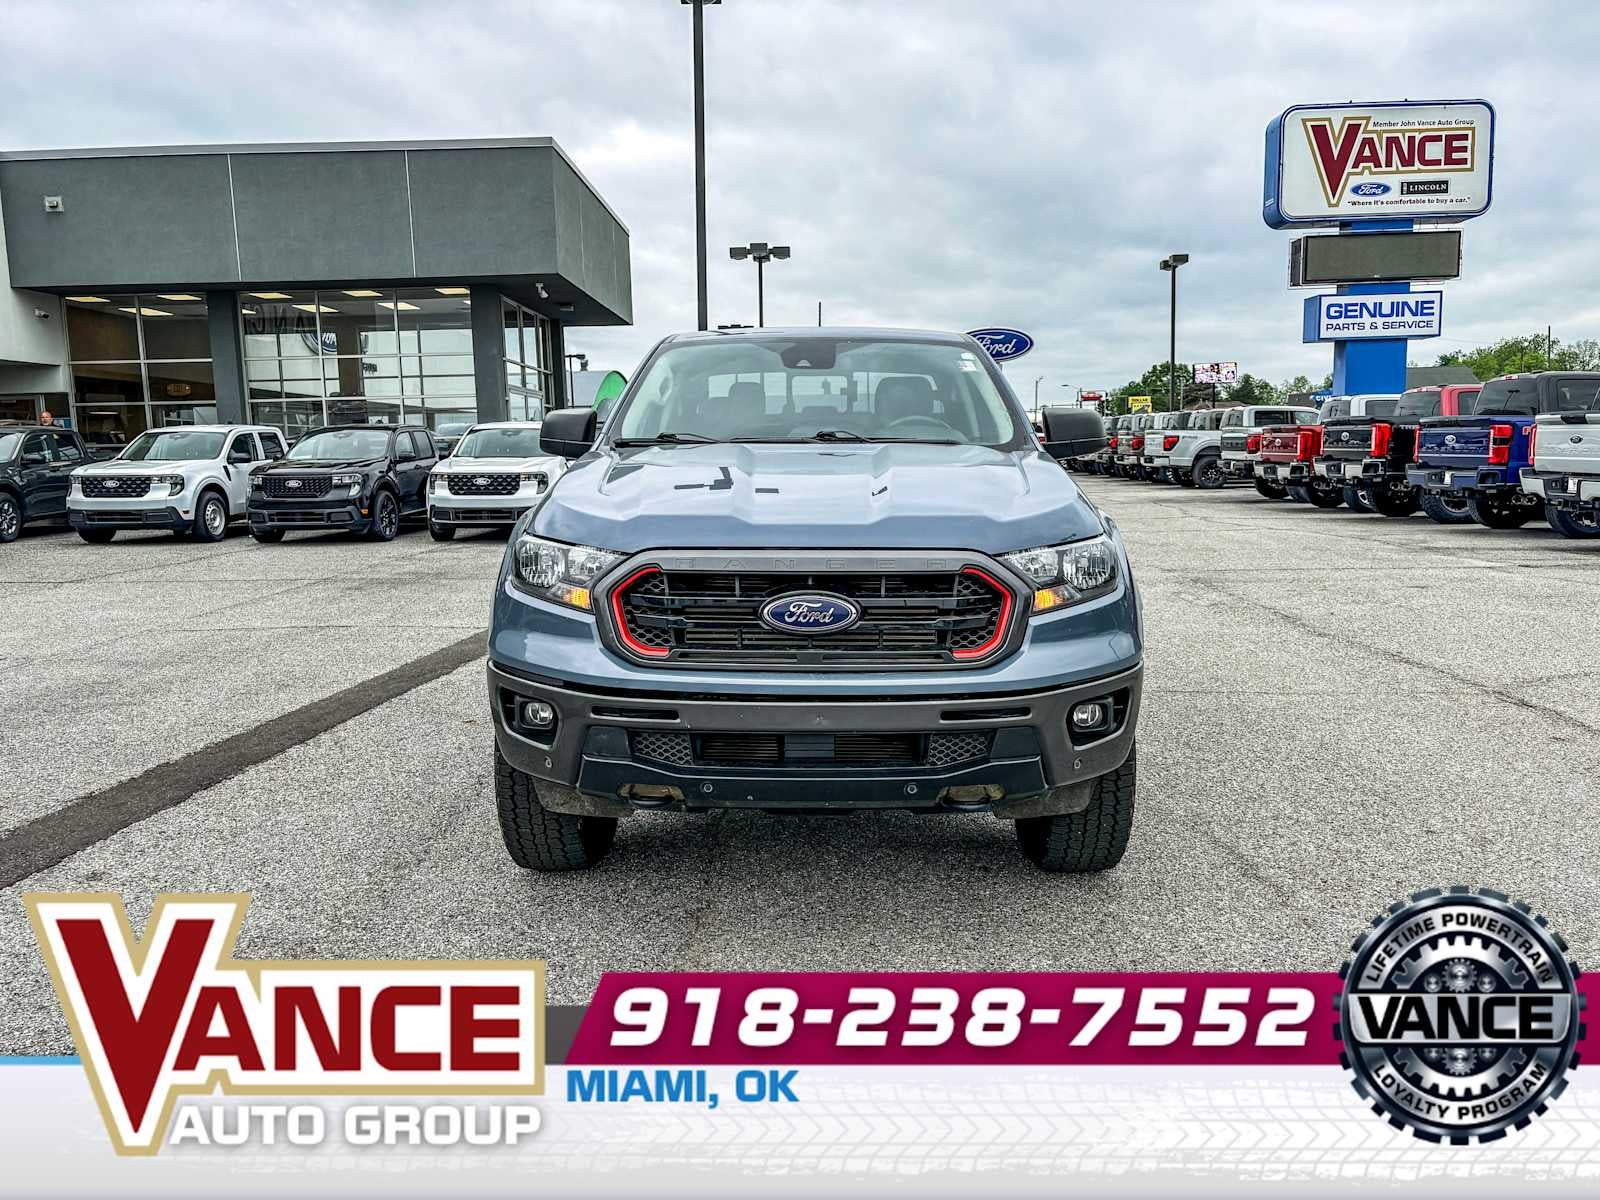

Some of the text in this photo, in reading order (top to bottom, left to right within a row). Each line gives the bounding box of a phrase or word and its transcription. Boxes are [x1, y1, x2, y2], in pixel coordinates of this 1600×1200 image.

[1454, 118, 1475, 126] Group
[1311, 123, 1469, 199] VANCE
[1358, 183, 1384, 195] Ford
[1409, 183, 1447, 191] LINCOLN
[1436, 197, 1448, 205] buy
[1326, 300, 1435, 320] GENUINE
[1326, 320, 1434, 331] PARTS & SERVICE
[976, 334, 1017, 354] Ford
[675, 558, 947, 569] RANGER
[784, 601, 835, 623] Ford
